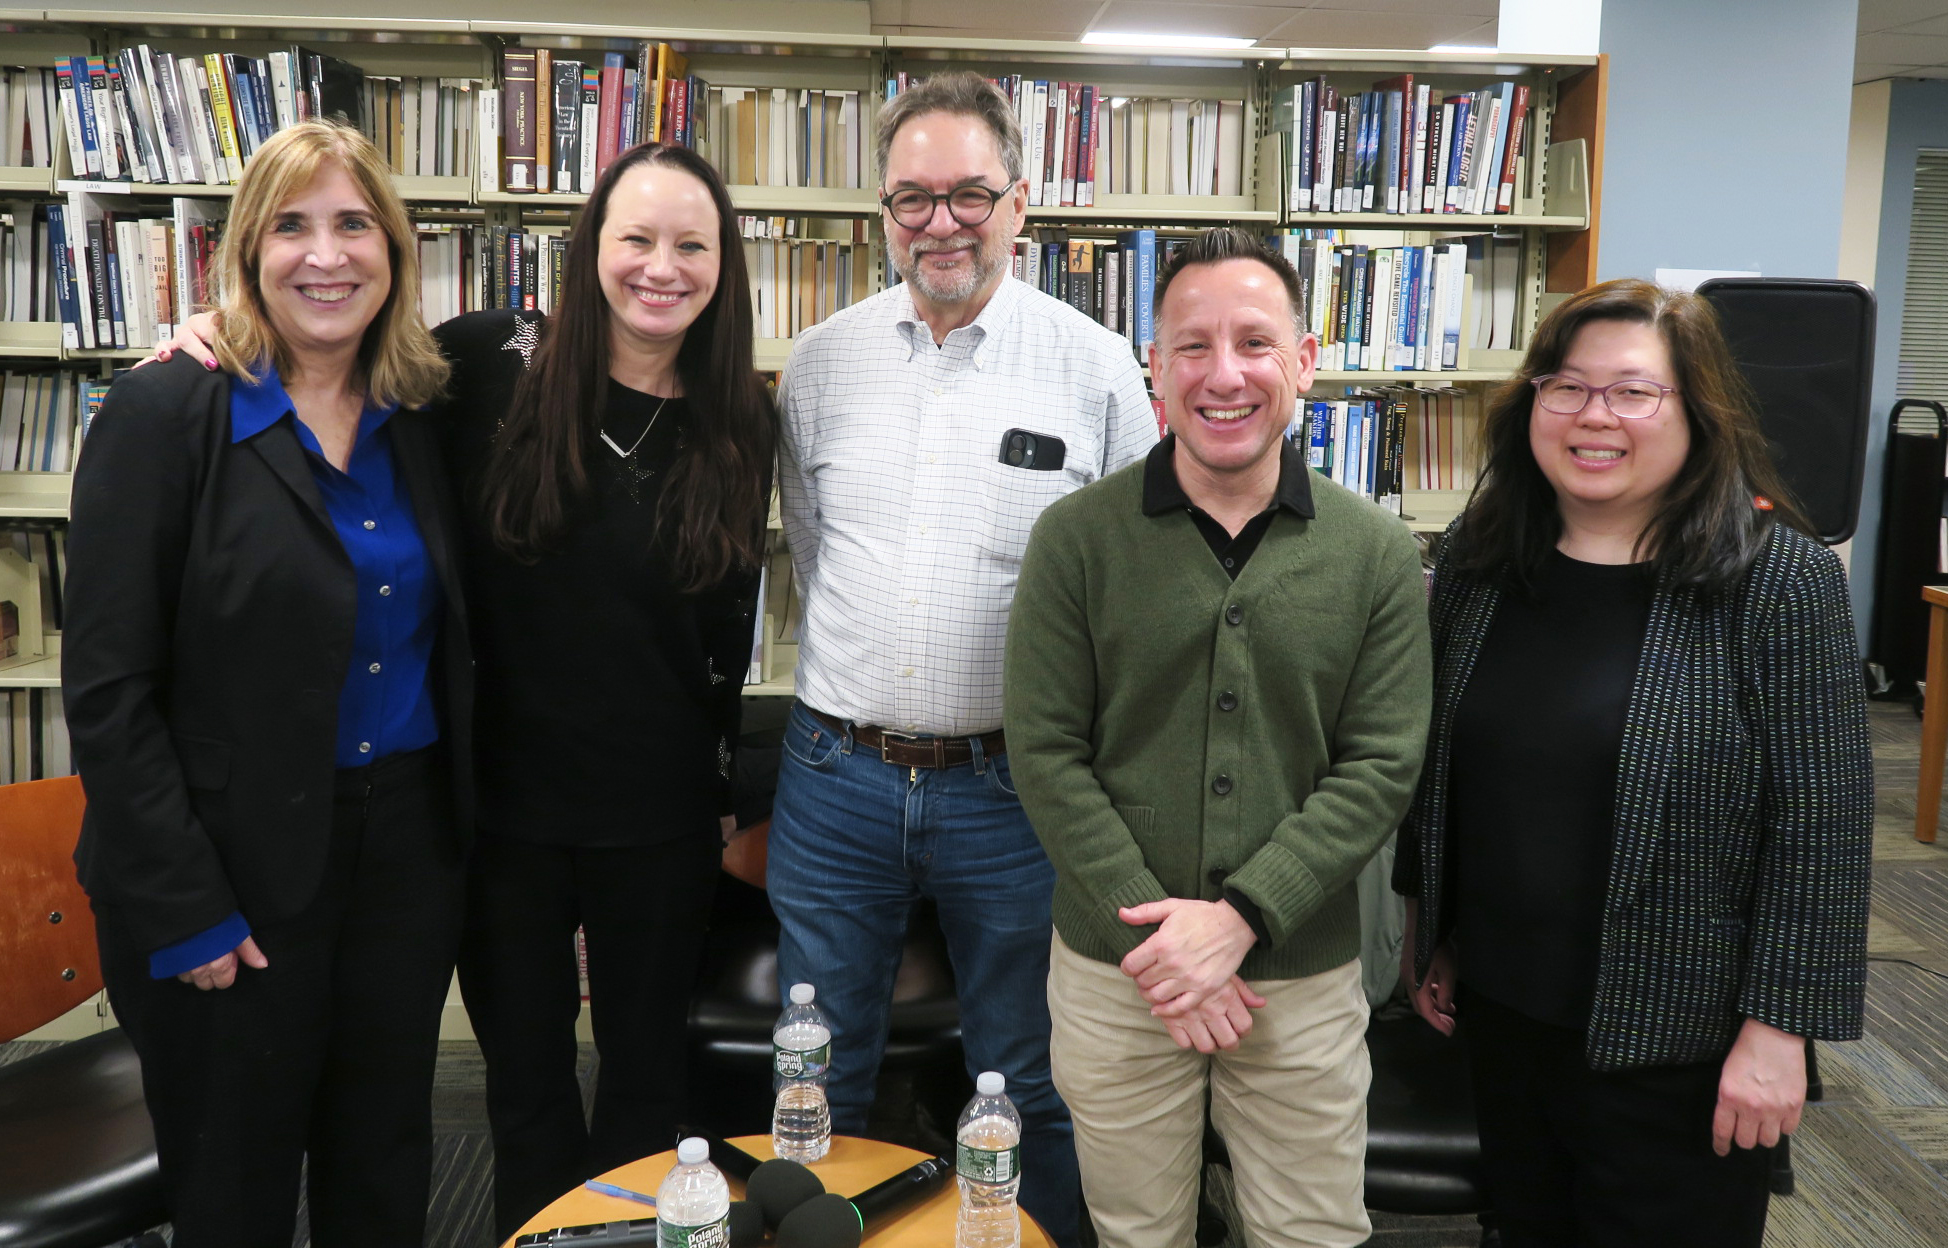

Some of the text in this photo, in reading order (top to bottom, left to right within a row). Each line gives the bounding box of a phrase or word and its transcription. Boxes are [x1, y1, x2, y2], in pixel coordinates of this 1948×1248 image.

[80, 83, 88, 110] AMERICAN
[1489, 107, 1500, 138] PORNOGRAPHY
[1459, 114, 1477, 181] LETHAL LOGIC
[496, 234, 506, 309] The Fourth Sta
[510, 238, 519, 286] UNDAUNTED
[1029, 248, 1037, 276] DYING
[1403, 251, 1411, 278] Recycle
[62, 266, 70, 300] Procedure
[93, 263, 102, 293] PENALTY
[98, 294, 104, 304] ON
[556, 273, 560, 281] OF
[1392, 292, 1400, 316] REVISITED
[1399, 294, 1408, 324] Essential
[1411, 277, 1419, 317] THROWAWAY
[776, 1052, 801, 1063] Poland
[777, 1061, 802, 1071] Spring
[688, 1221, 723, 1246] Poland
